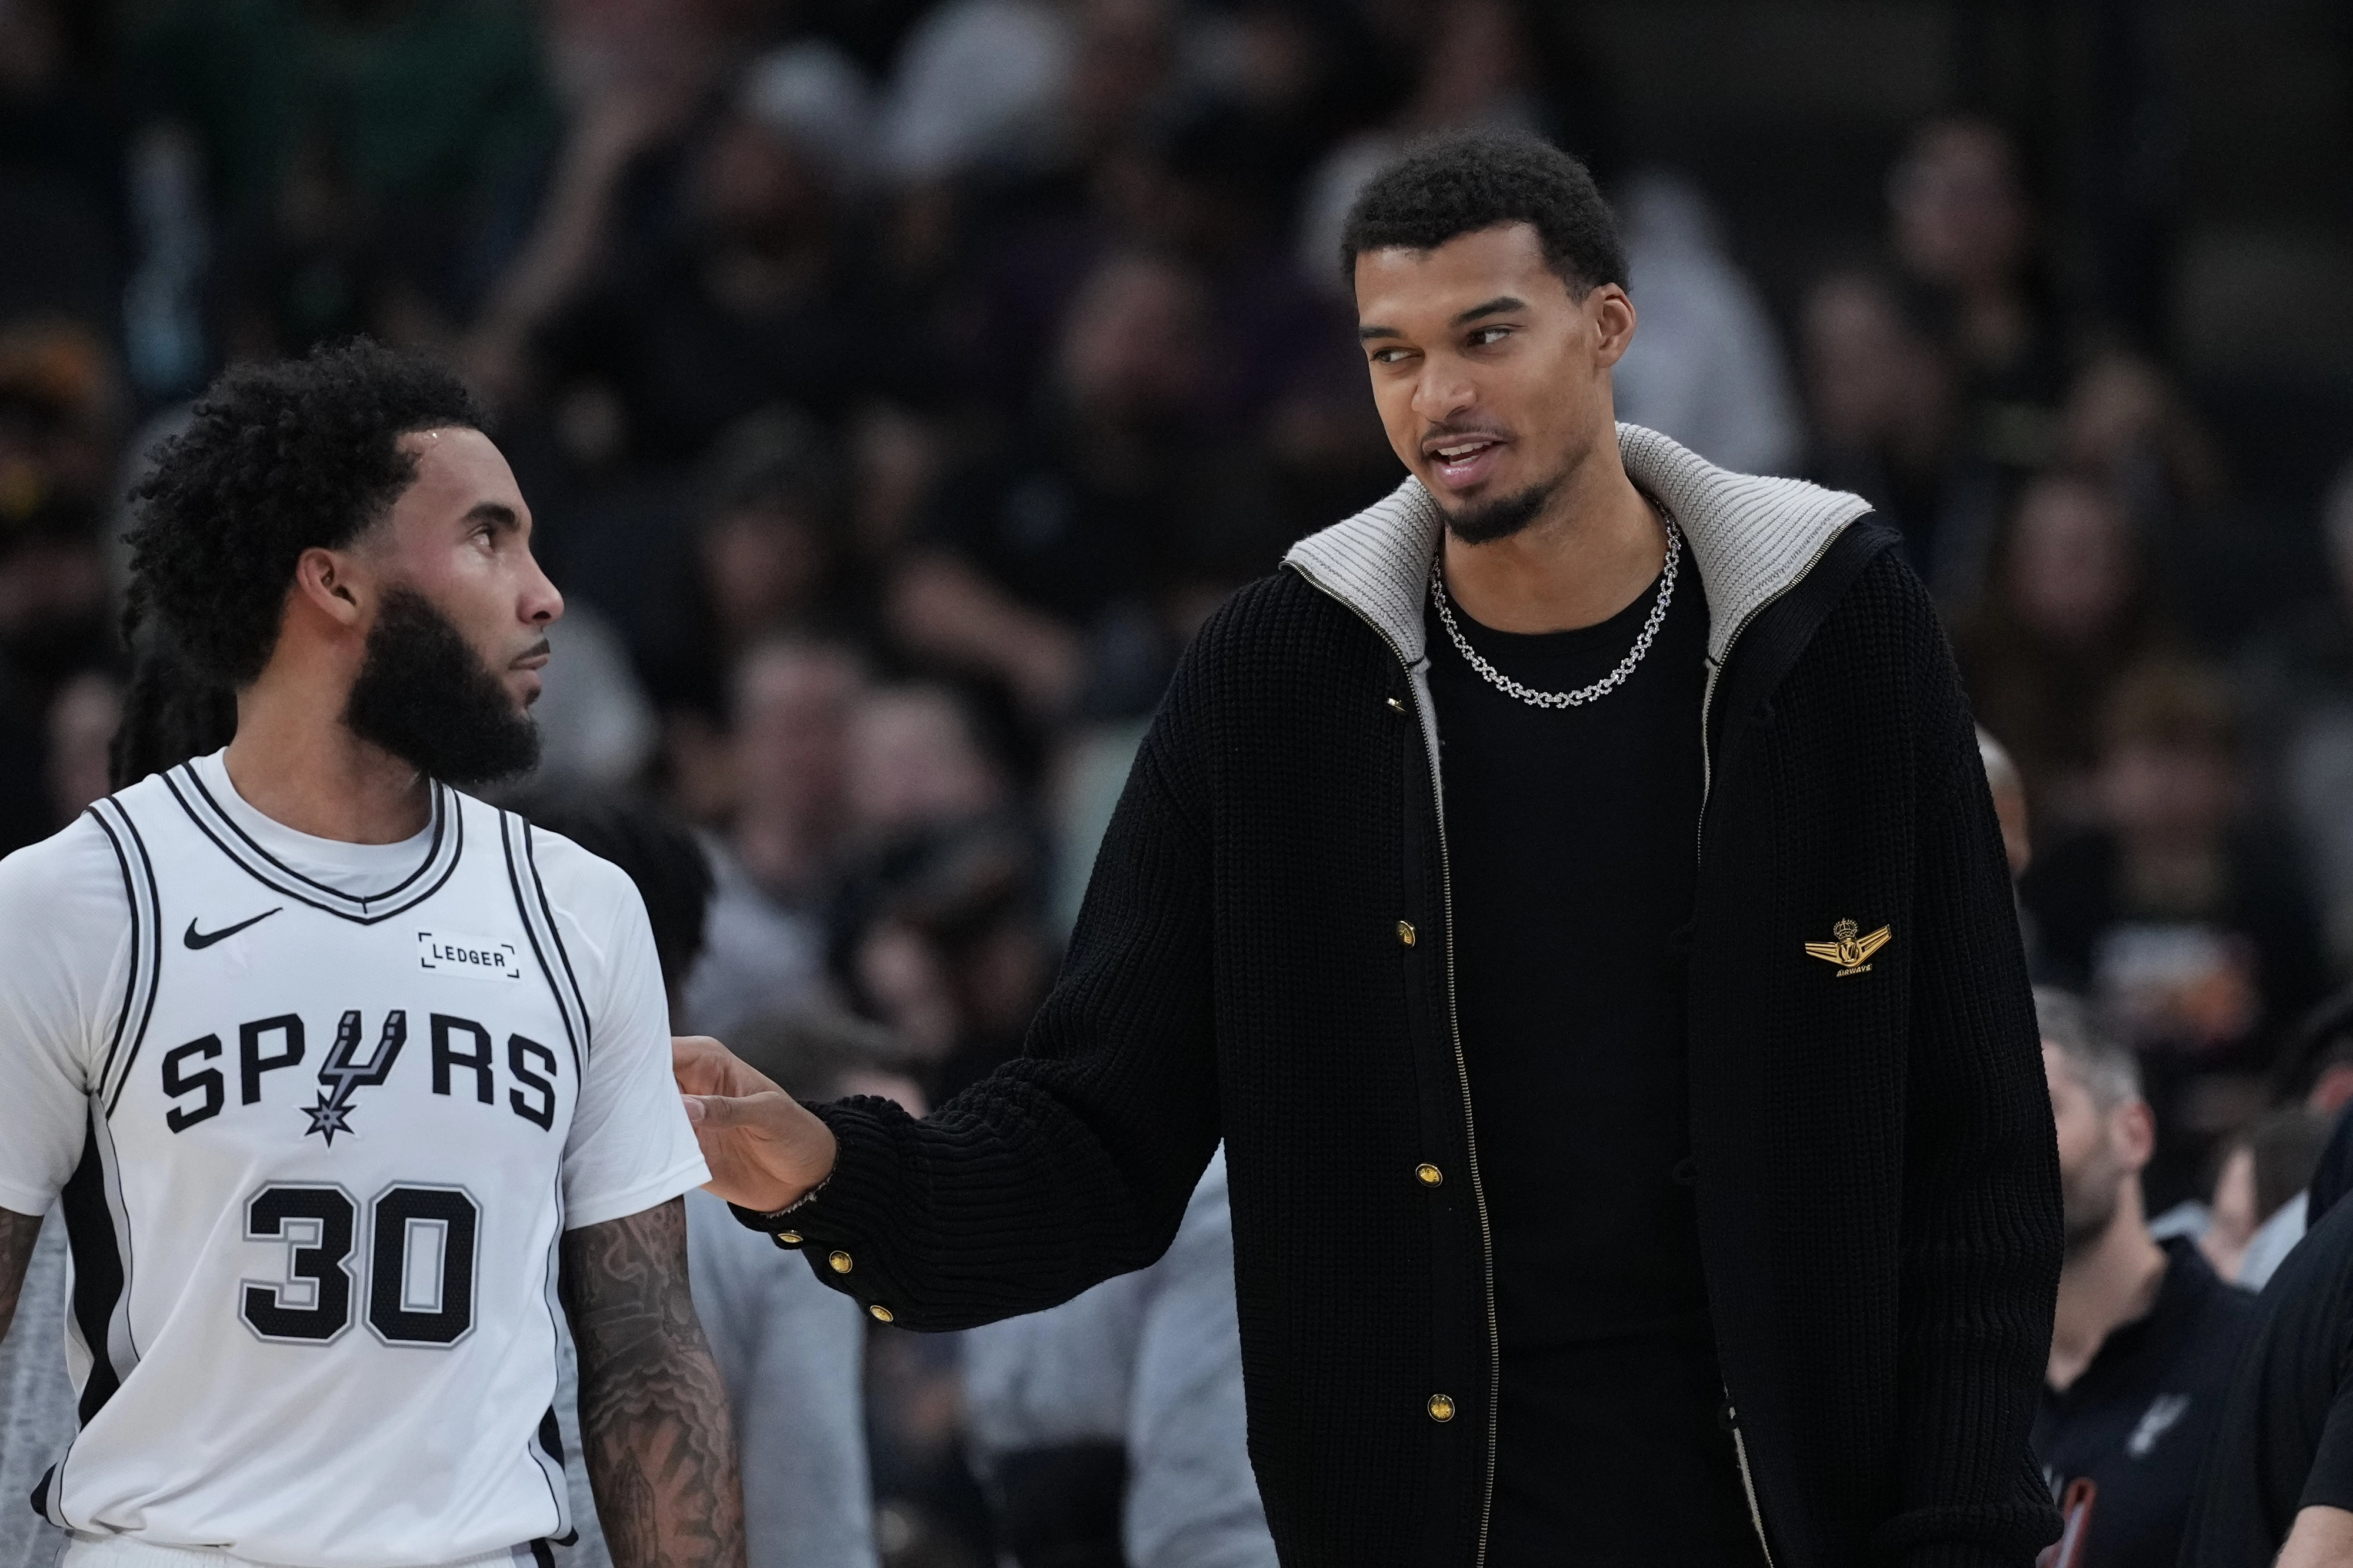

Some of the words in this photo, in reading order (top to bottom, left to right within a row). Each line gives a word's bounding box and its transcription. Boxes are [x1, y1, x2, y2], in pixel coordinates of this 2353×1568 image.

[432, 943, 505, 967] LEDGER
[1836, 963, 1872, 977] AIRWAYS
[162, 1009, 557, 1147] SPURS
[238, 1180, 484, 1350] 30
